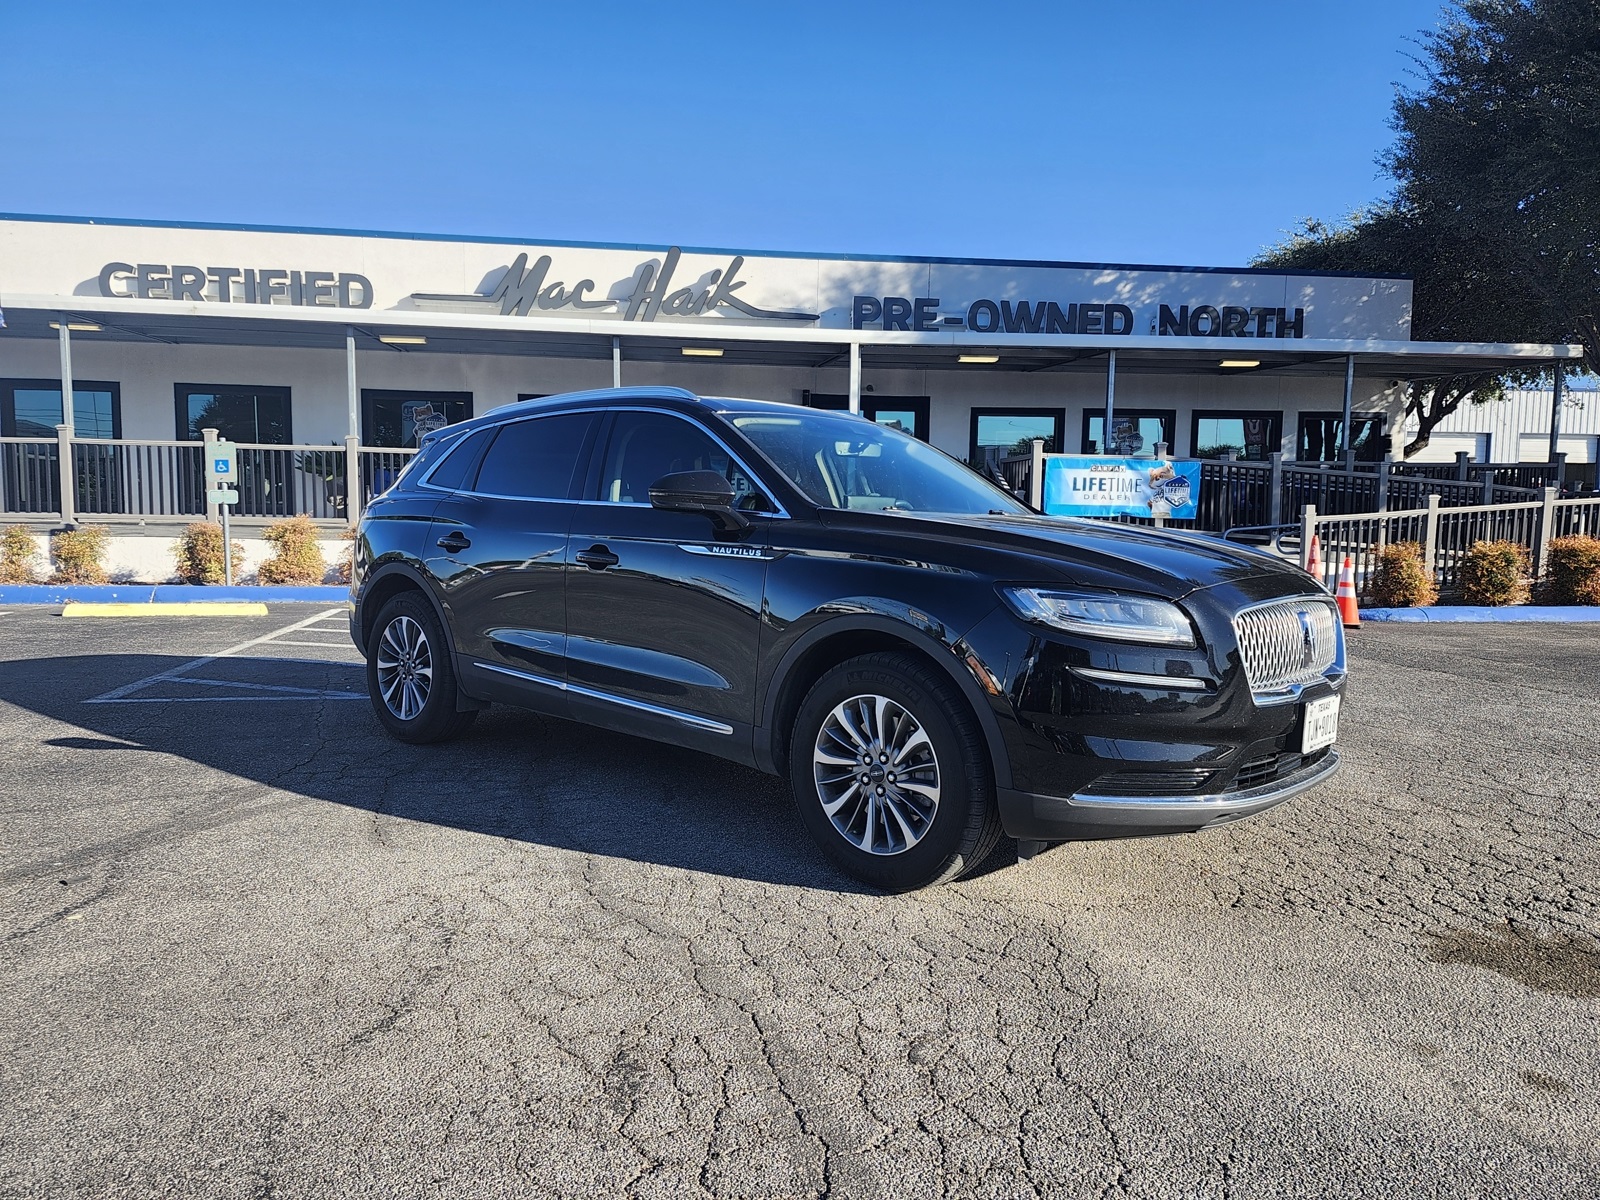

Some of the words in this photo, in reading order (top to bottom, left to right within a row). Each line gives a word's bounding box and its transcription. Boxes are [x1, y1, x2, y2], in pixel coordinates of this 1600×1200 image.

[99, 262, 374, 309] CERTIFIED
[411, 253, 617, 316] Mac
[623, 246, 820, 321] Haik
[852, 296, 1134, 335] PRE-OWNED
[1158, 303, 1305, 338] NORTH
[1091, 464, 1126, 473] CARFAX
[1072, 477, 1143, 494] LIFETIME
[712, 546, 762, 557] NAUTILUS
[861, 671, 921, 702] MICHELIN
